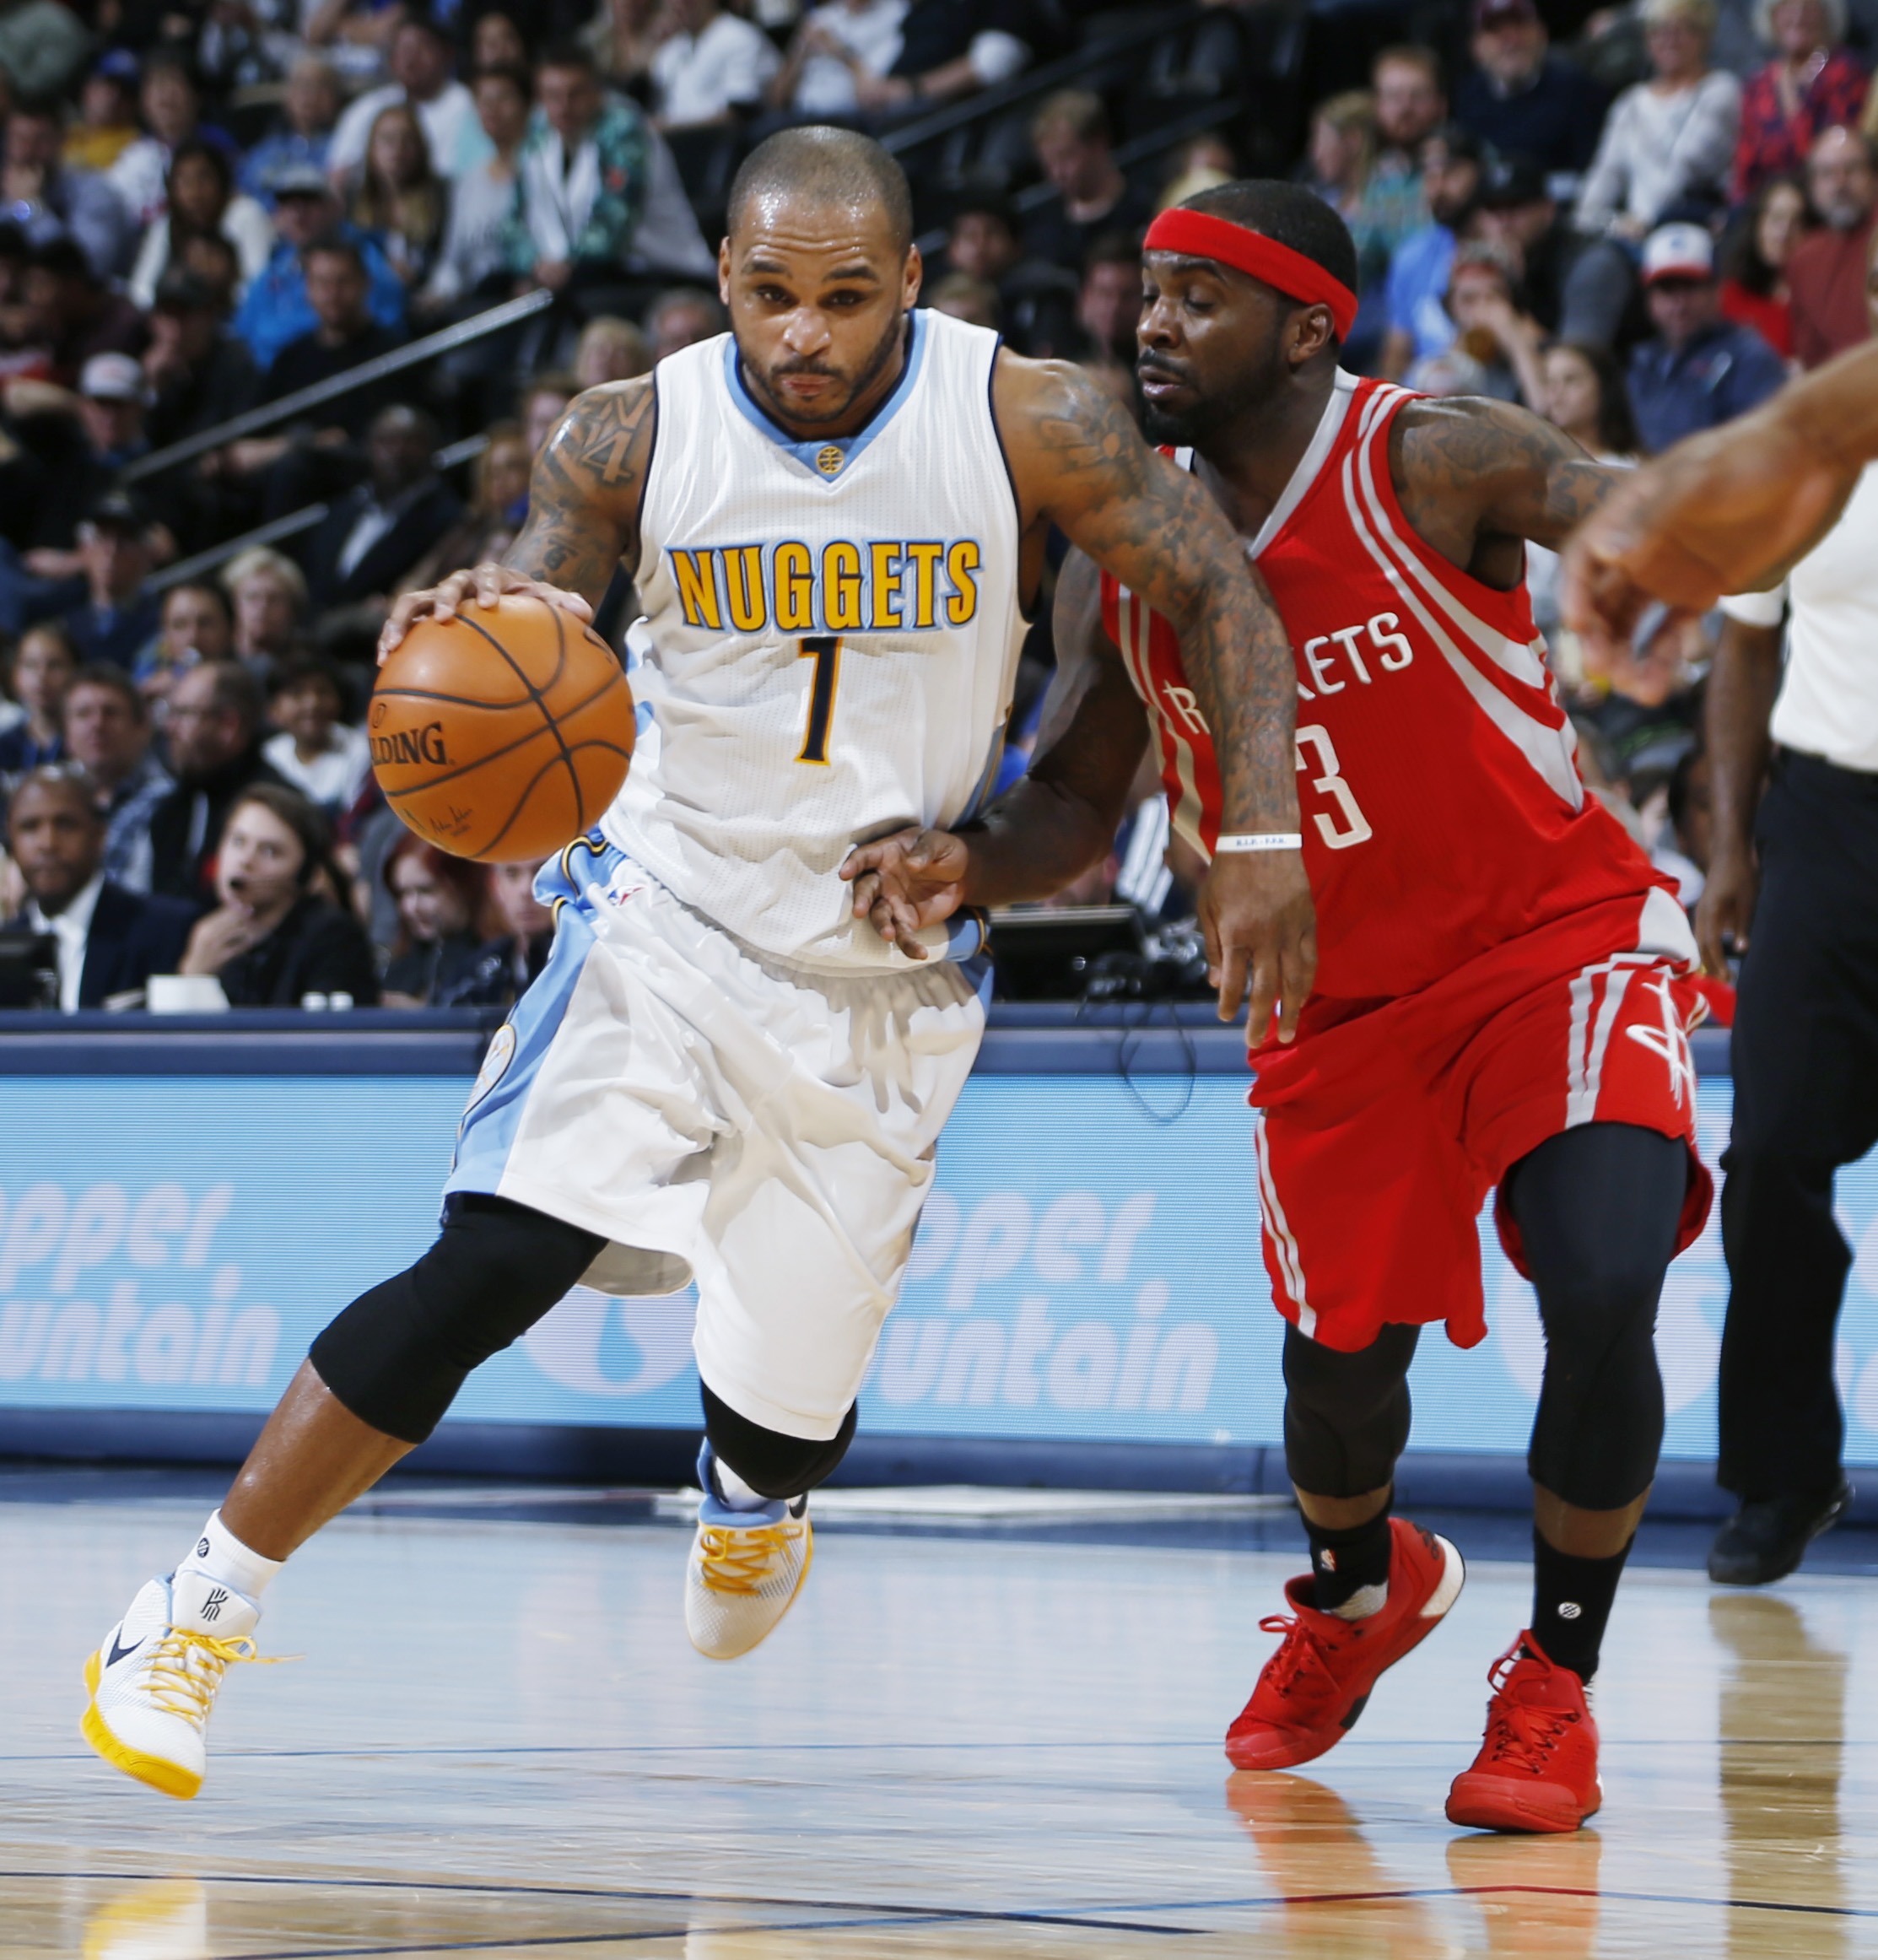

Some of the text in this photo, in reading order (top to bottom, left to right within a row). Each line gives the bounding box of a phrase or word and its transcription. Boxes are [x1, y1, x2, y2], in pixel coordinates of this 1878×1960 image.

[665, 537, 984, 634] NUGGETS
[369, 721, 447, 765] LDING
[794, 636, 843, 766] 1
[1295, 724, 1373, 850] 3
[0, 1180, 236, 1295] pper
